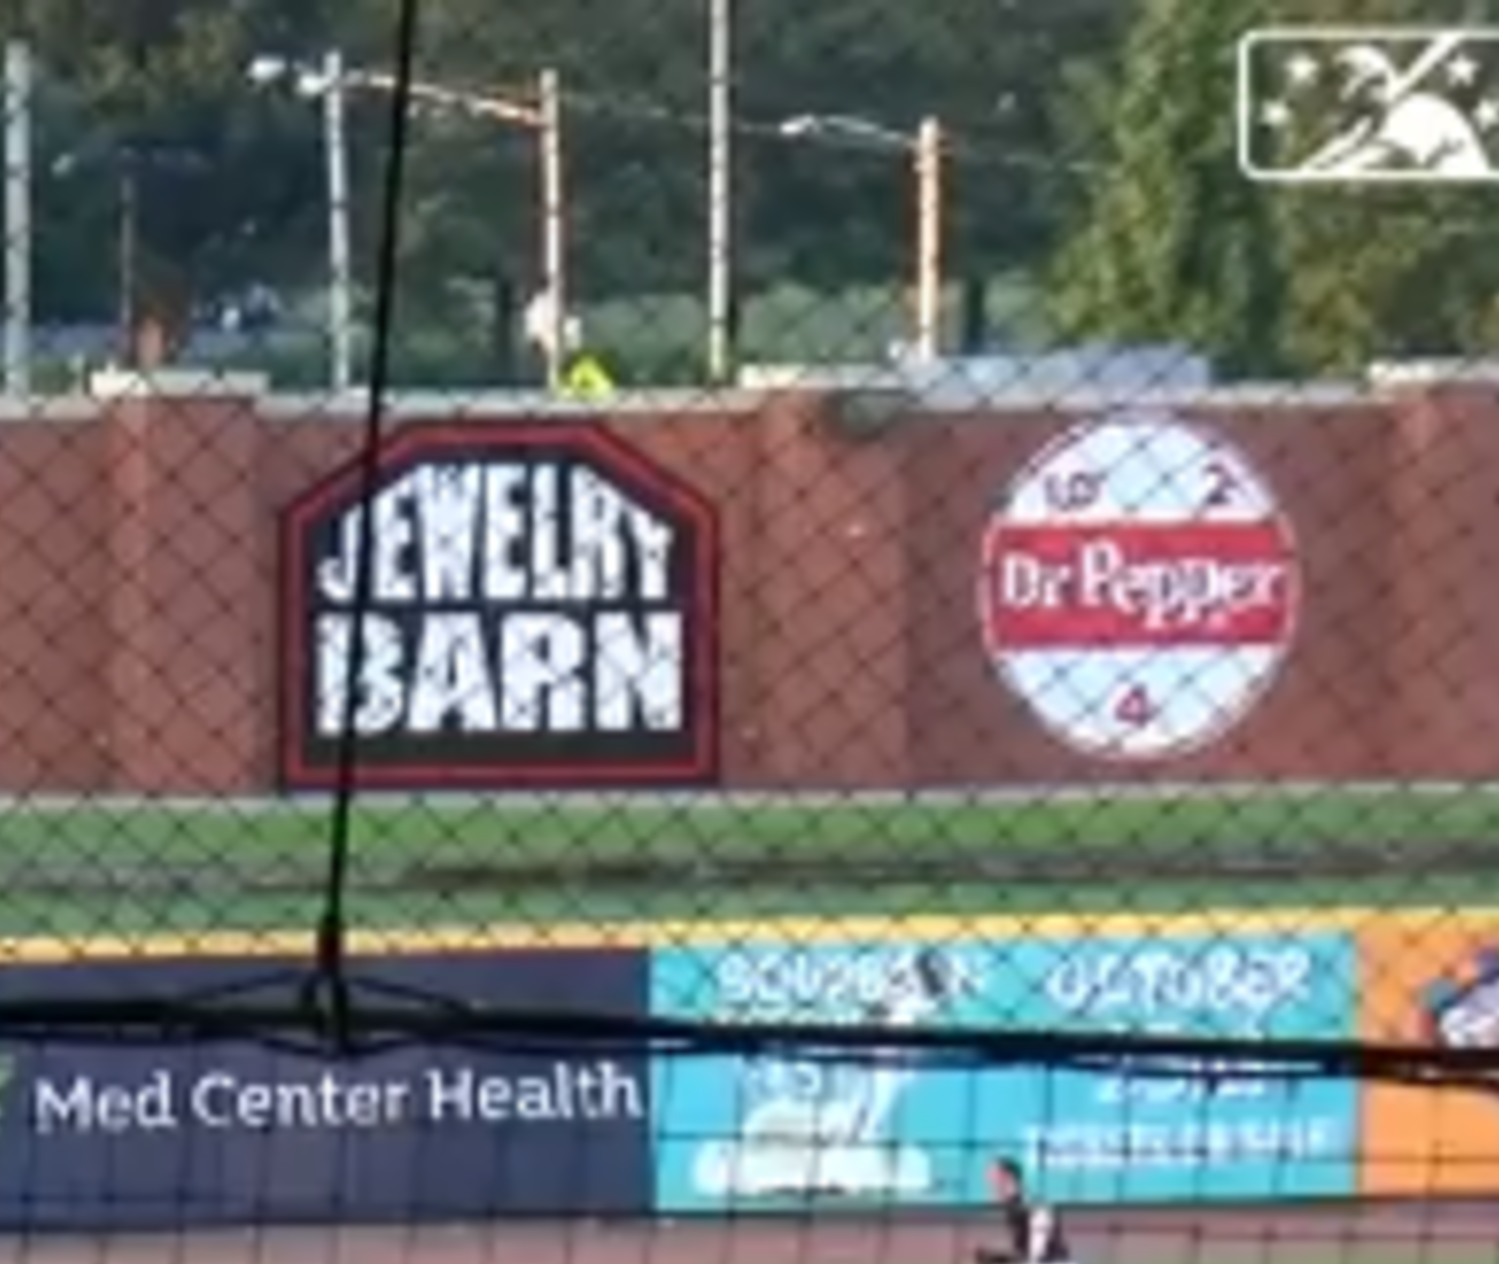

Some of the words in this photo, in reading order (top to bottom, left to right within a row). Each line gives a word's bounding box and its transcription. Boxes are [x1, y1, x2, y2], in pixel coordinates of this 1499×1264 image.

[1201, 461, 1241, 505] 2
[316, 463, 674, 602] JEWELRY
[1003, 553, 1074, 607] Dr
[1080, 537, 1283, 631] Pepper
[315, 610, 684, 735] BARN
[1113, 684, 1157, 728] 4
[34, 1070, 176, 1133] Med
[190, 1070, 411, 1128] Center
[427, 1061, 645, 1121] Health
